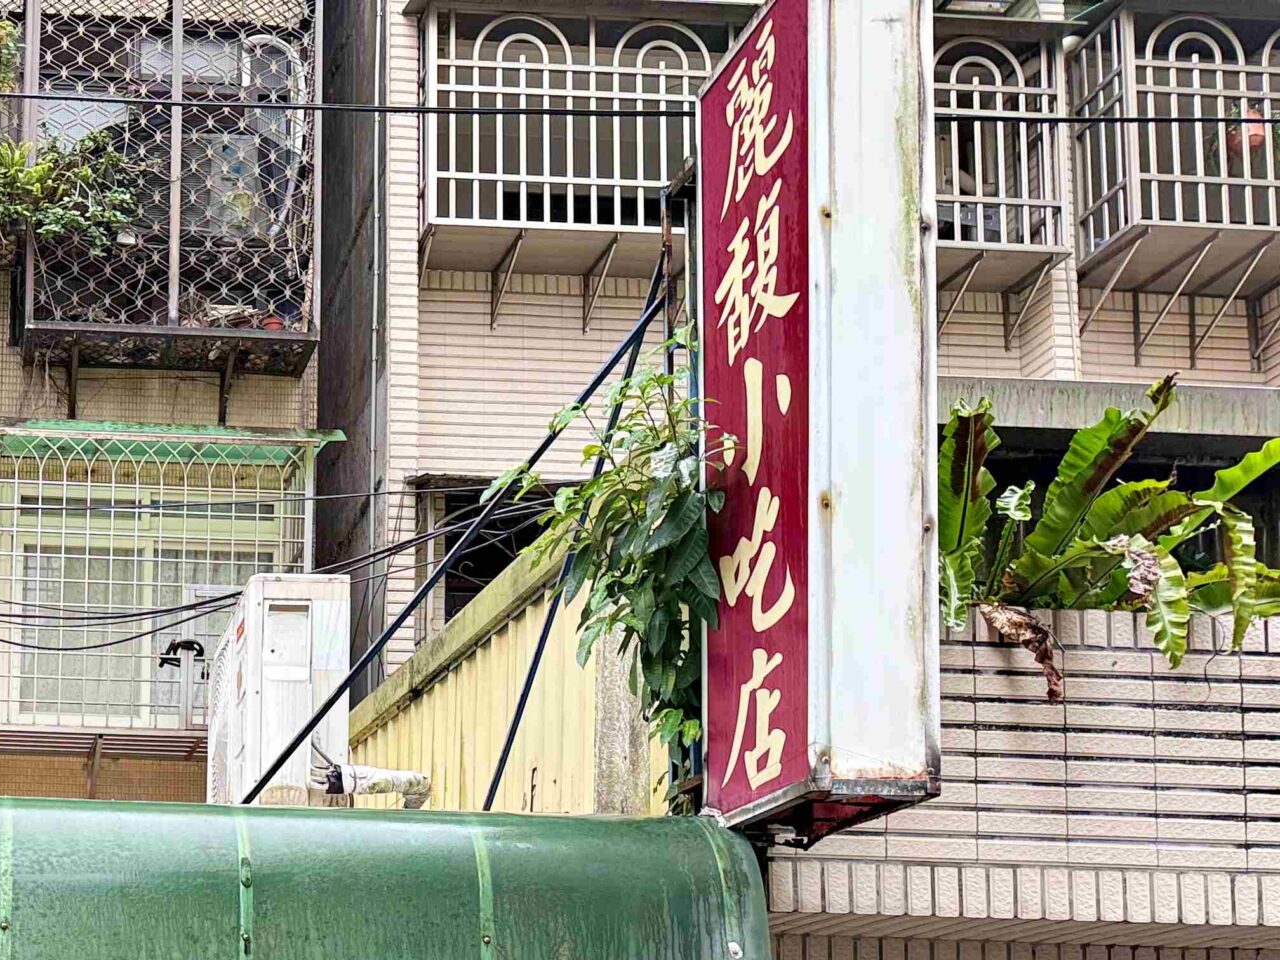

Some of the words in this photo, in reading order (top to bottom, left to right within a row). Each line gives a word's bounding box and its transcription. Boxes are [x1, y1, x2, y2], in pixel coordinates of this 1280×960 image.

[714, 19, 801, 792] 麗馥小吃店
